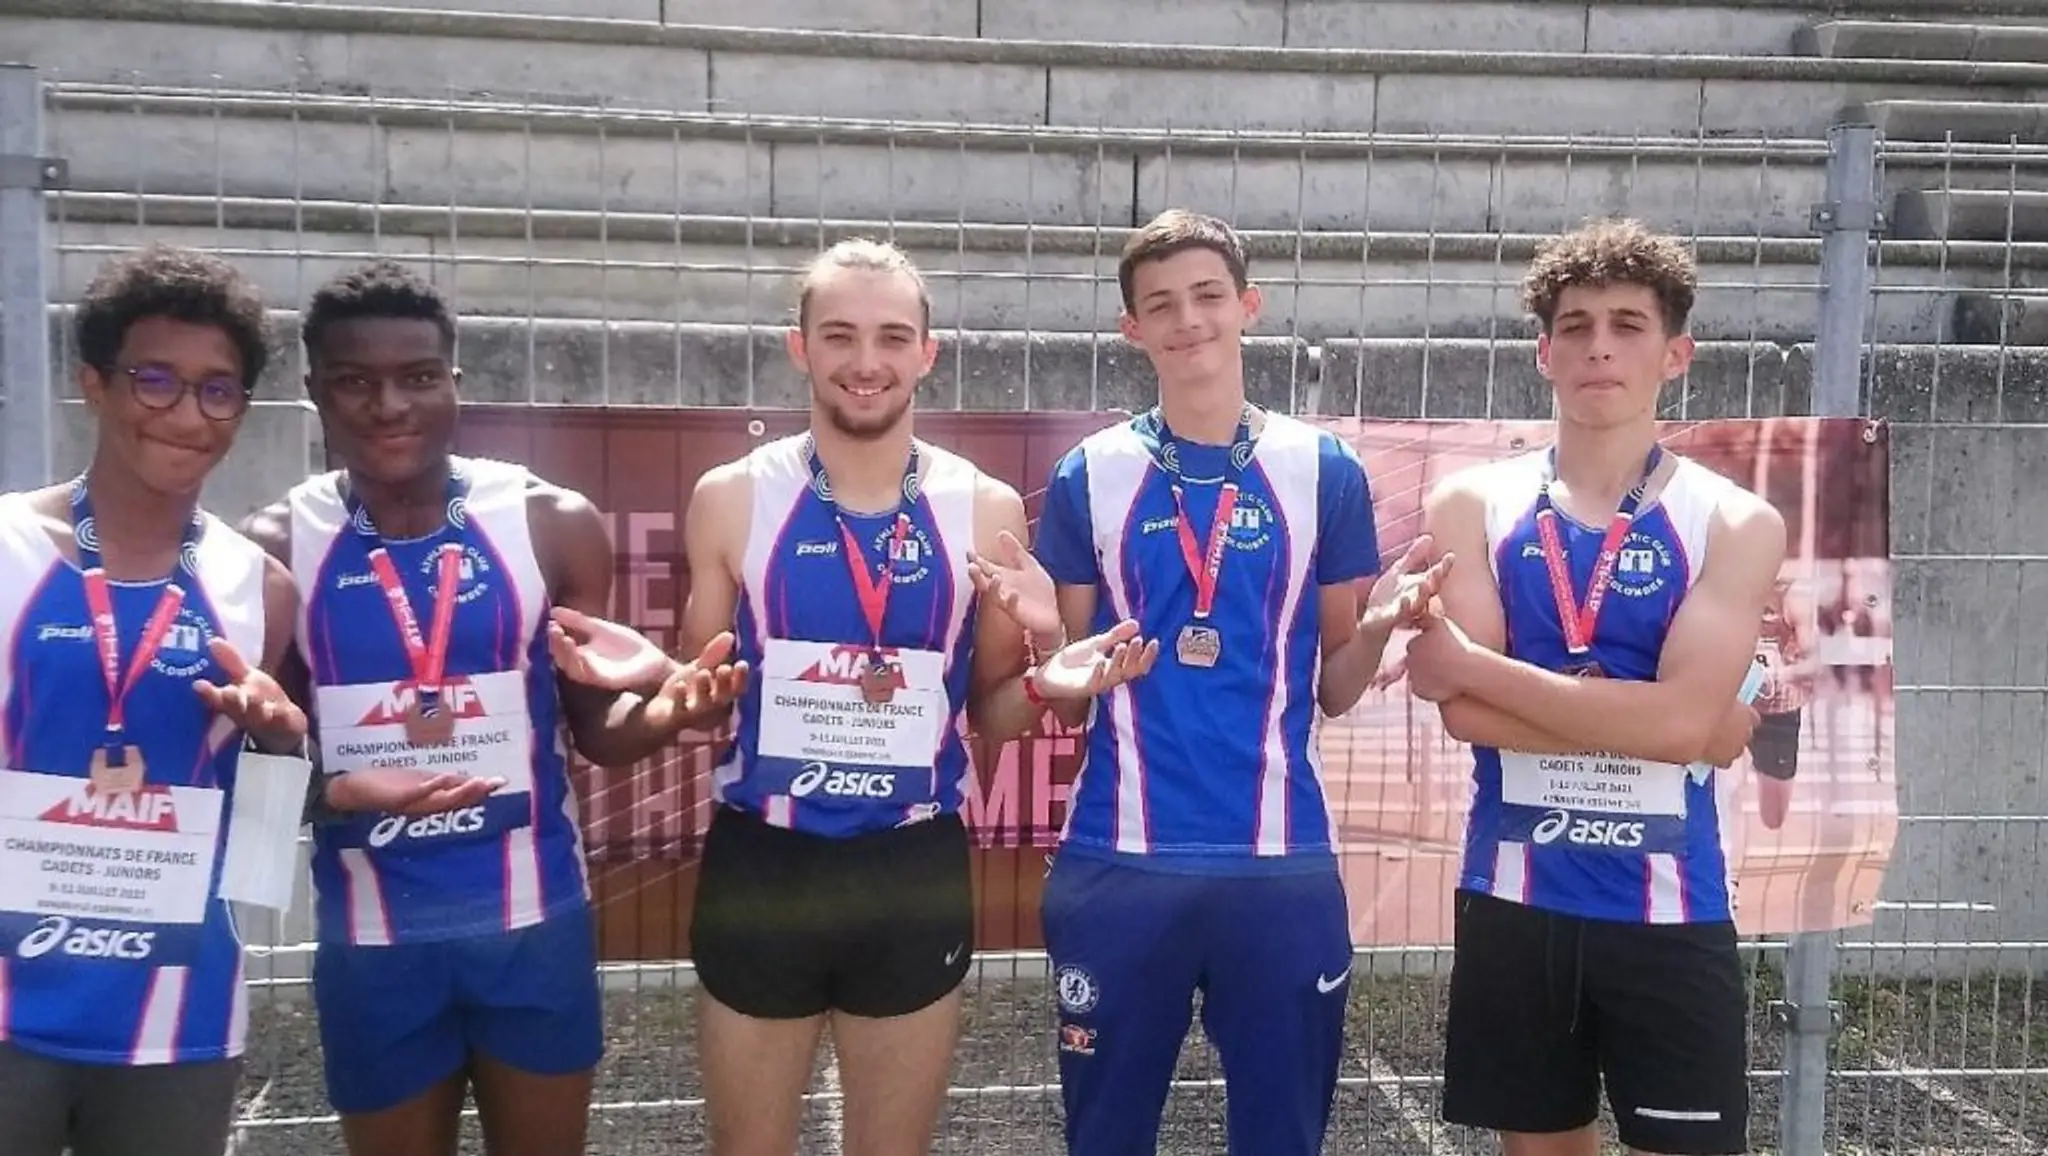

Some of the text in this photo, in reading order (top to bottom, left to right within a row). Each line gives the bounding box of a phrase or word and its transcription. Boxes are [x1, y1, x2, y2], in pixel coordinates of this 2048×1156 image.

[796, 541, 839, 555] poli
[774, 695, 863, 714] CHAMPIONNATS
[883, 704, 924, 718] FRANCE
[802, 712, 844, 726] CADETS
[461, 731, 511, 746] FRANCE
[68, 790, 175, 824] MAIF
[5, 838, 198, 866] CHAMPIONNATS DE FRANCE
[41, 859, 94, 876] CADETS
[103, 865, 162, 881] JUNIORS
